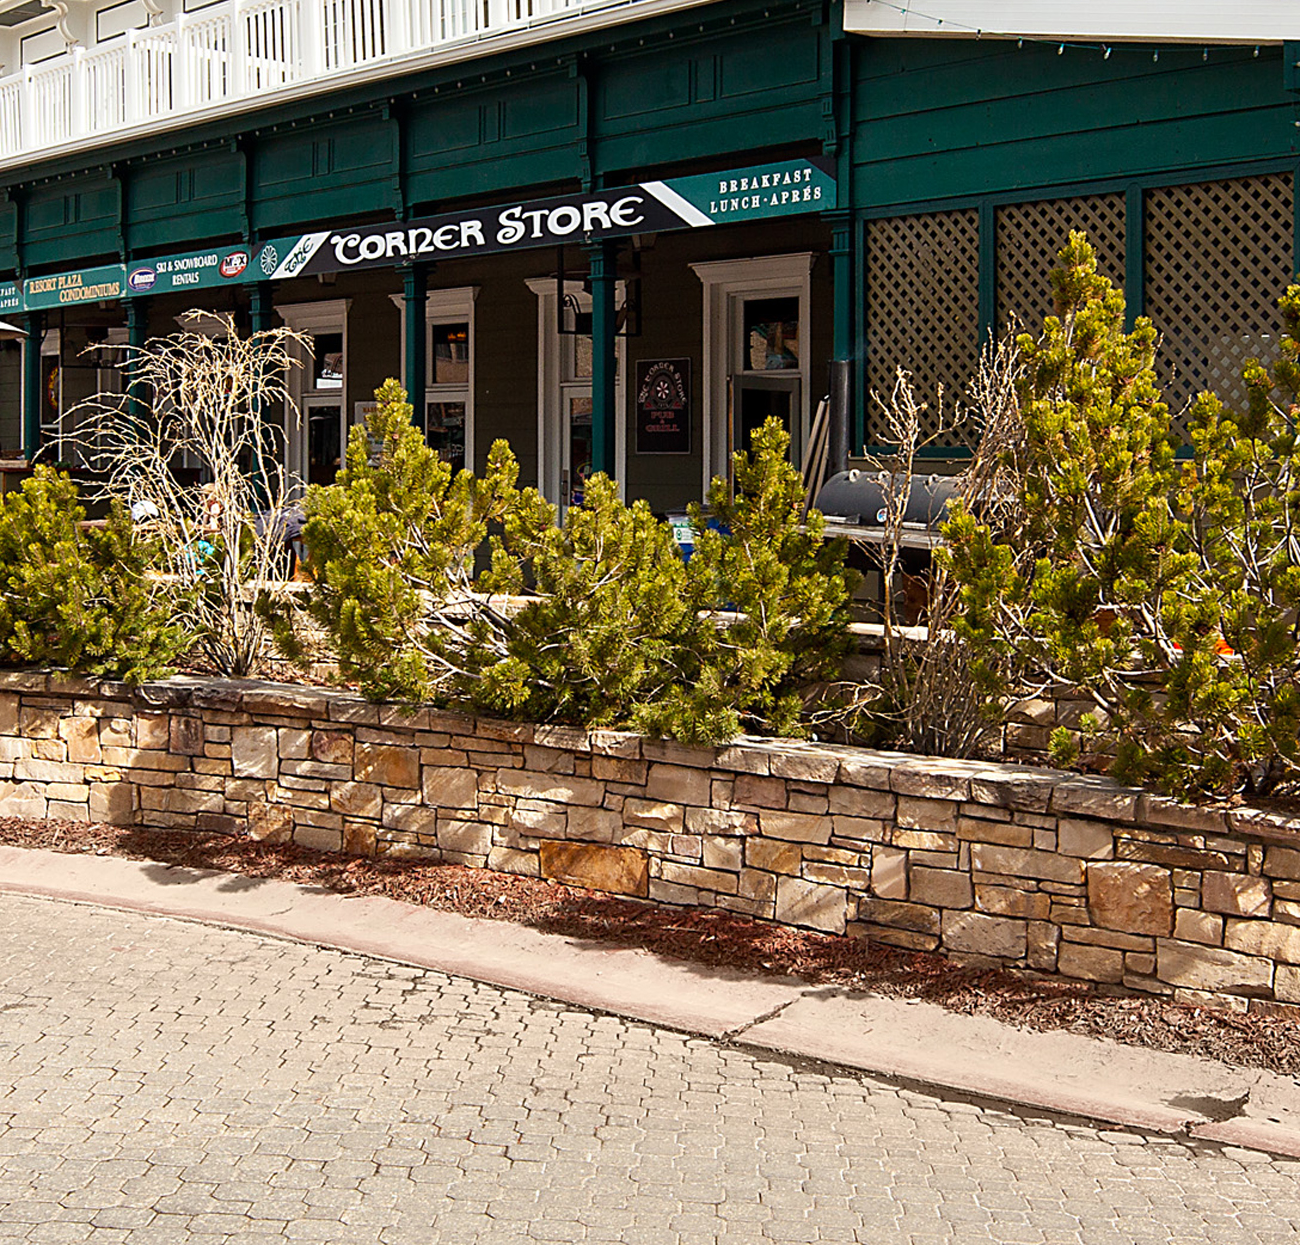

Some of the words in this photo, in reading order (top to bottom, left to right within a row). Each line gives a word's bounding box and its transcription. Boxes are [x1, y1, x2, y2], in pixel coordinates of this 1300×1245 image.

[719, 168, 812, 194] BREAKFAST
[497, 196, 644, 245] STORE
[167, 261, 174, 272] &
[174, 254, 218, 271] SNOWBOARD
[29, 277, 57, 294] RESORT
[58, 274, 83, 289] PLAZA
[172, 272, 200, 286] RENTALS
[59, 282, 119, 302] CONDOMINIUMS
